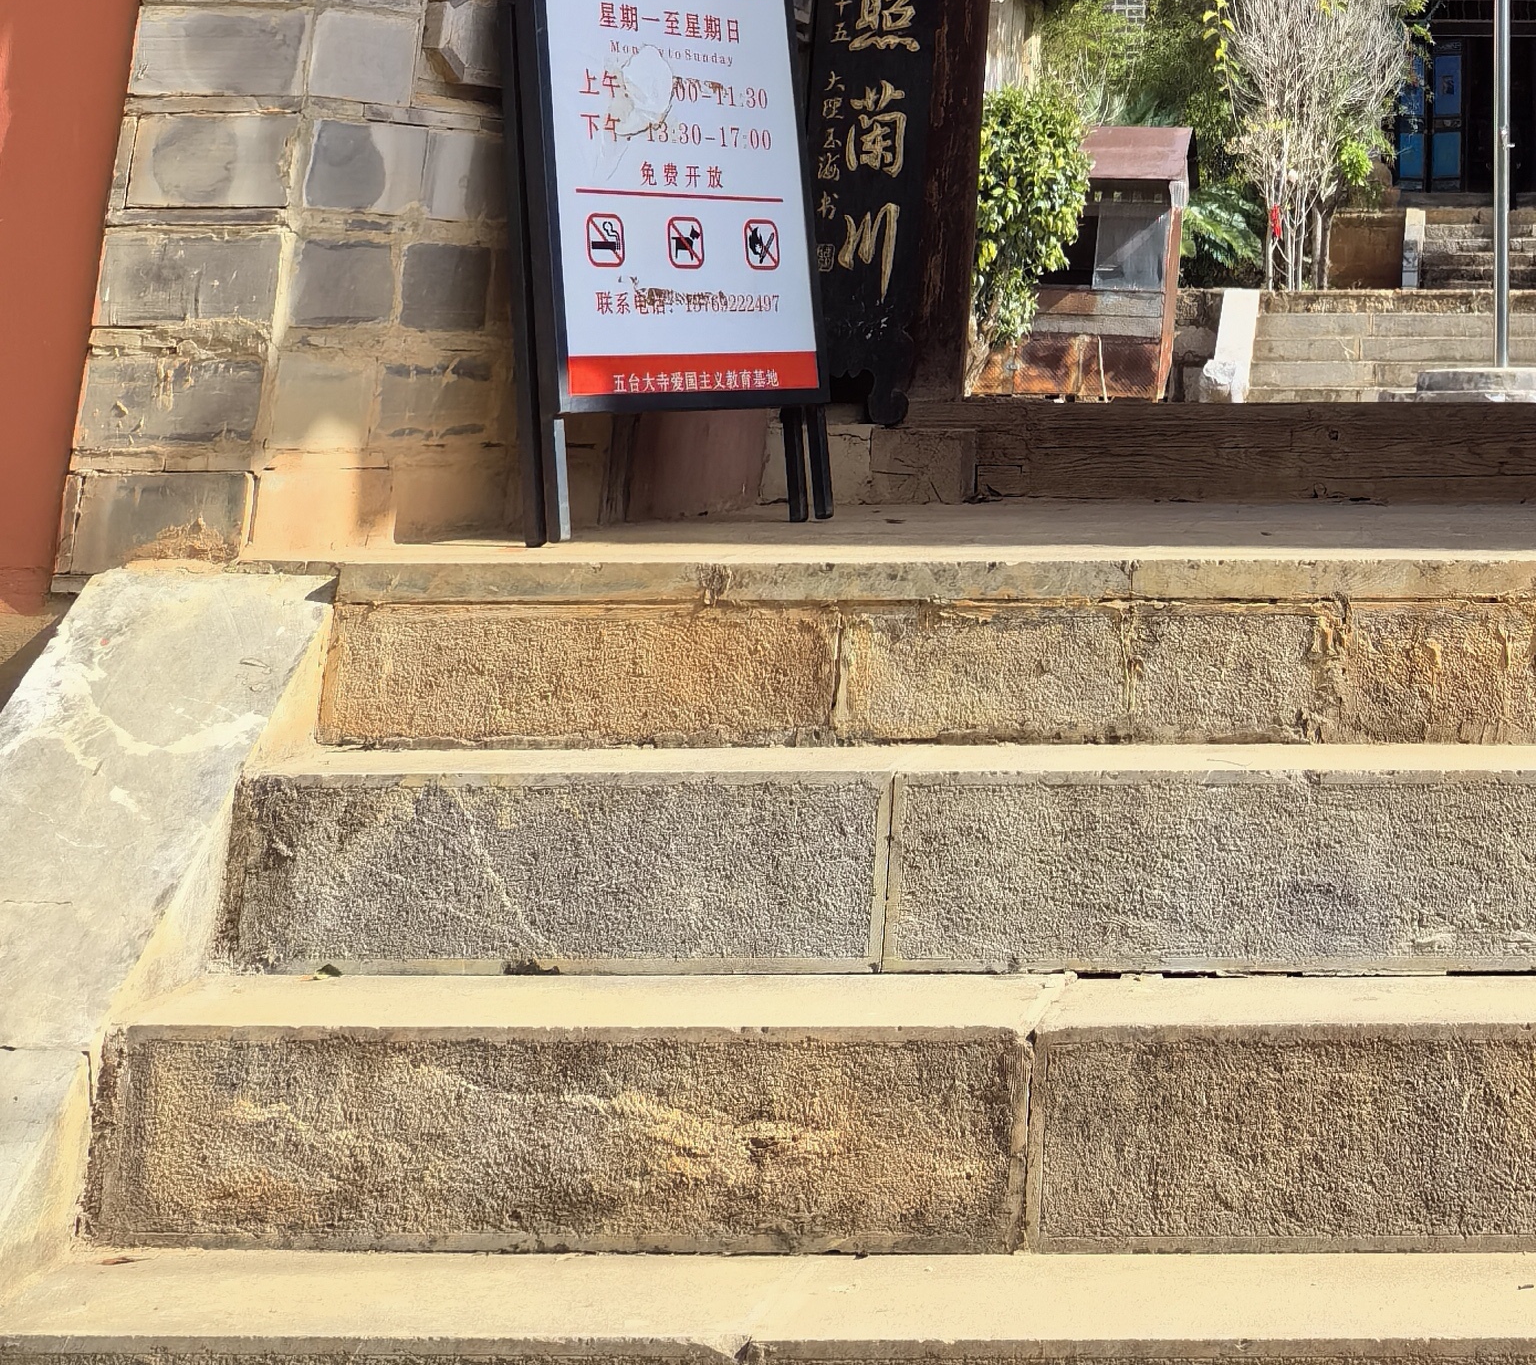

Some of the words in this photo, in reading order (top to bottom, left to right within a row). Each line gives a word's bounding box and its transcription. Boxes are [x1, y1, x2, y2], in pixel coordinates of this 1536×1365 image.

[599, 1, 740, 44] 星期一至星期日
[684, 48, 734, 67] Sunday
[640, 161, 725, 189] 免费开放
[613, 368, 781, 394] 五台大寺爱国主义教育基地
